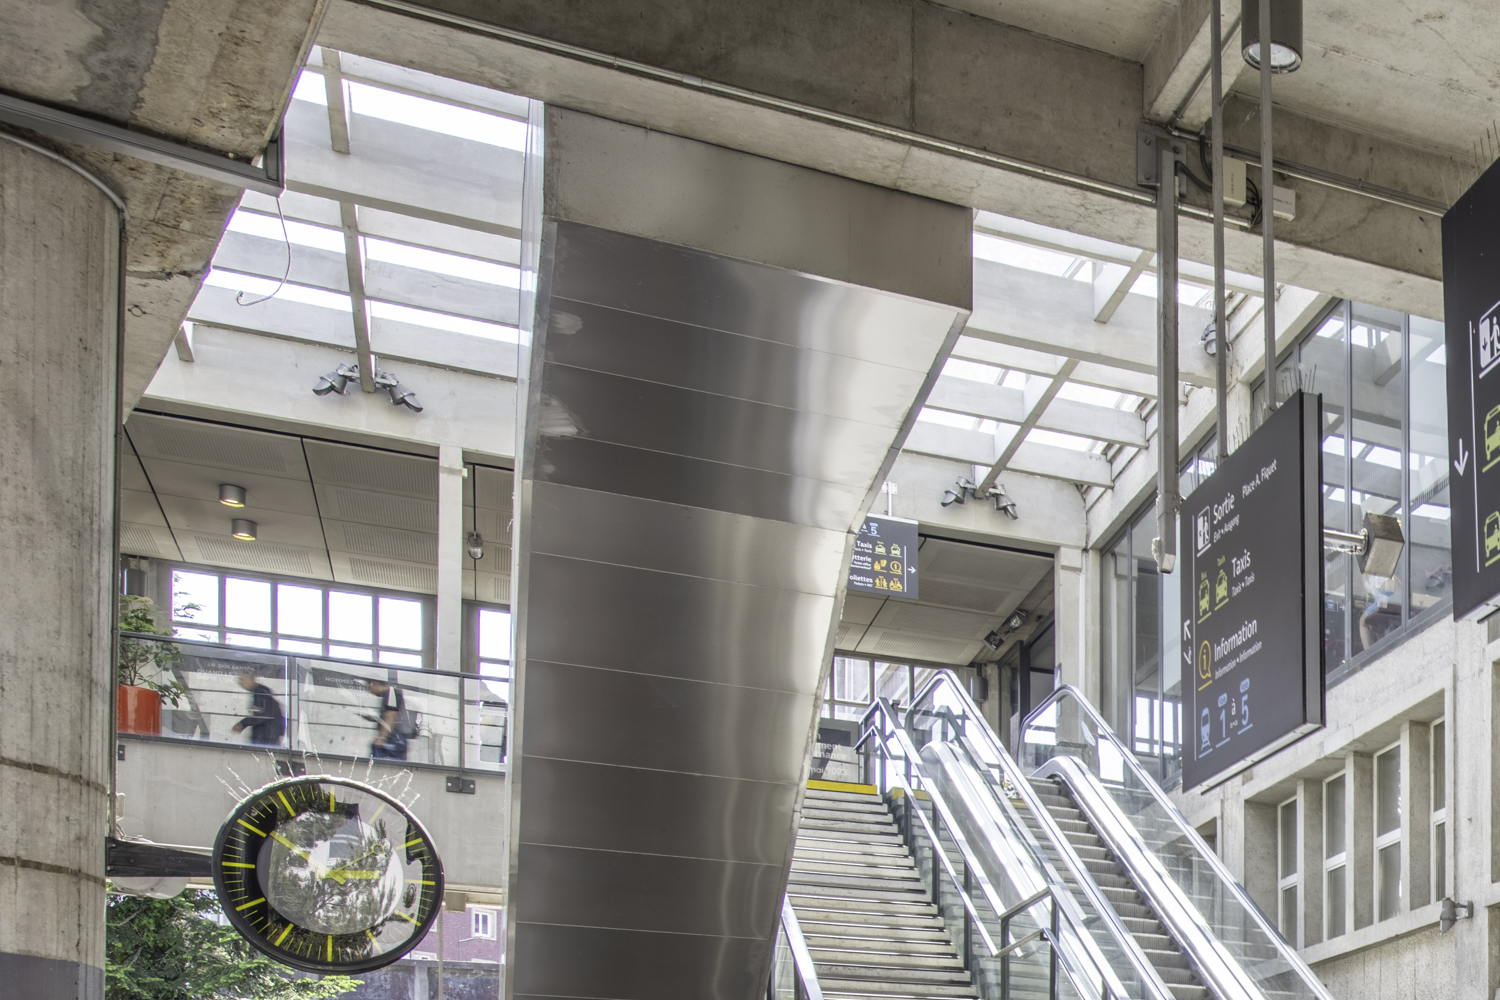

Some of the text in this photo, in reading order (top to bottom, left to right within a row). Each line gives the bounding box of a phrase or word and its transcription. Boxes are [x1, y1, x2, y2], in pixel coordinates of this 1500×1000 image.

[1242, 480, 1255, 498] Place
[1261, 459, 1277, 482] Fiquet
[1213, 492, 1235, 524] Sortie
[857, 540, 872, 548] Taxis
[870, 526, 877, 535] 5
[1231, 548, 1251, 578] Taxis
[1214, 620, 1258, 662] Information
[1231, 698, 1236, 716] à
[1242, 694, 1249, 726] 5
[1220, 708, 1226, 738] 1
